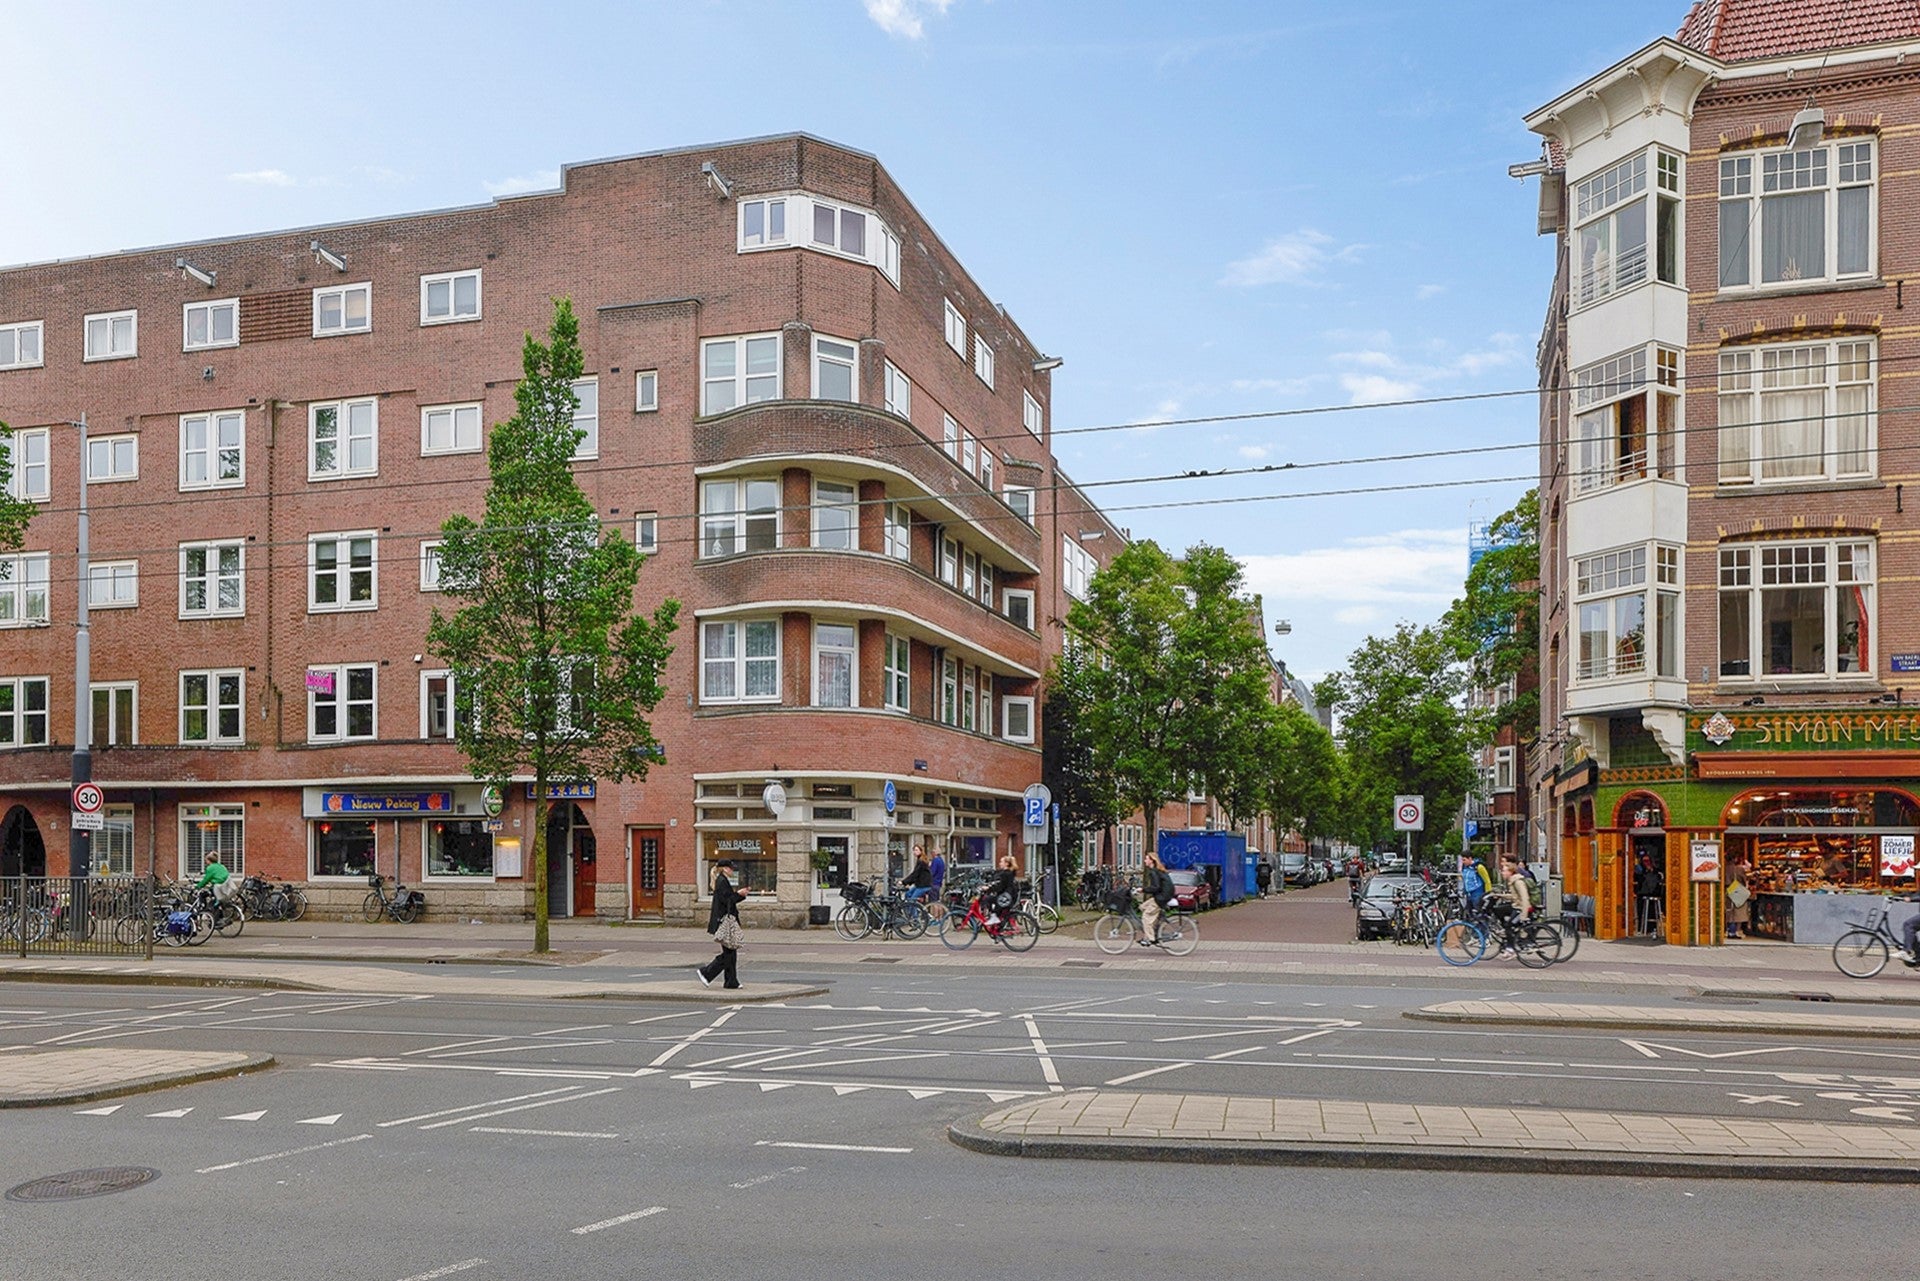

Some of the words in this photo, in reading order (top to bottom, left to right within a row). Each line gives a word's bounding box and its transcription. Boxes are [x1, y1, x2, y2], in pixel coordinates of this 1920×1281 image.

[1755, 720, 1852, 744] SIMON
[80, 792, 98, 804] 30
[351, 798, 382, 810] Nieuw
[386, 797, 420, 811] Peking
[1030, 800, 1041, 814] P
[1402, 809, 1416, 817] 30
[717, 840, 731, 848] VAN
[733, 840, 761, 848] BAERLE
